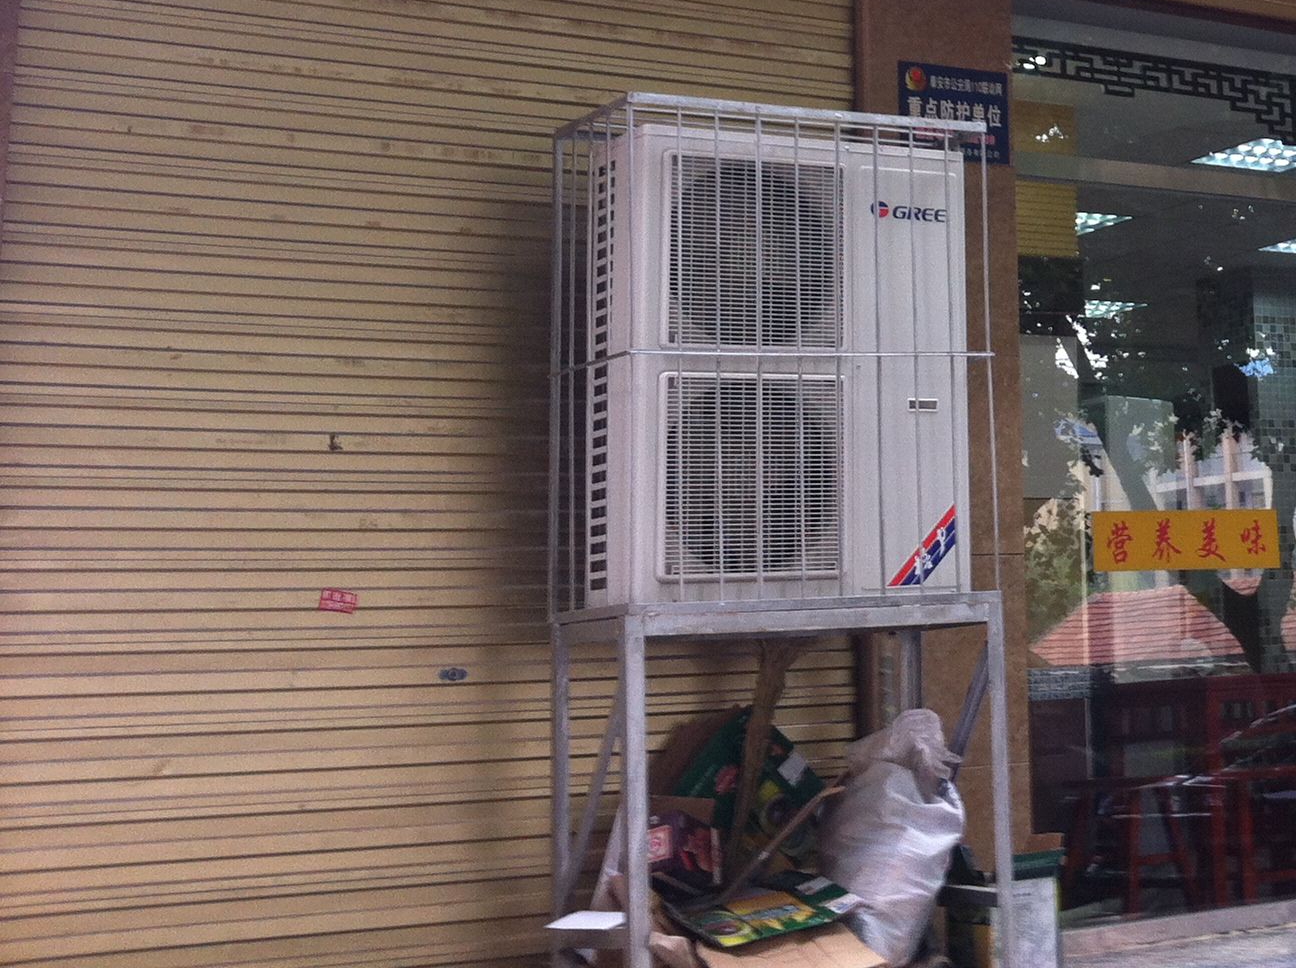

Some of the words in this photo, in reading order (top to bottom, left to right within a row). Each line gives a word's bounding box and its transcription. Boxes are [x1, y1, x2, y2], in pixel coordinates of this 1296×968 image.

[907, 96, 1002, 127] 重点防护单位
[892, 205, 948, 223] GREE
[1106, 517, 1267, 565] 营养美味
